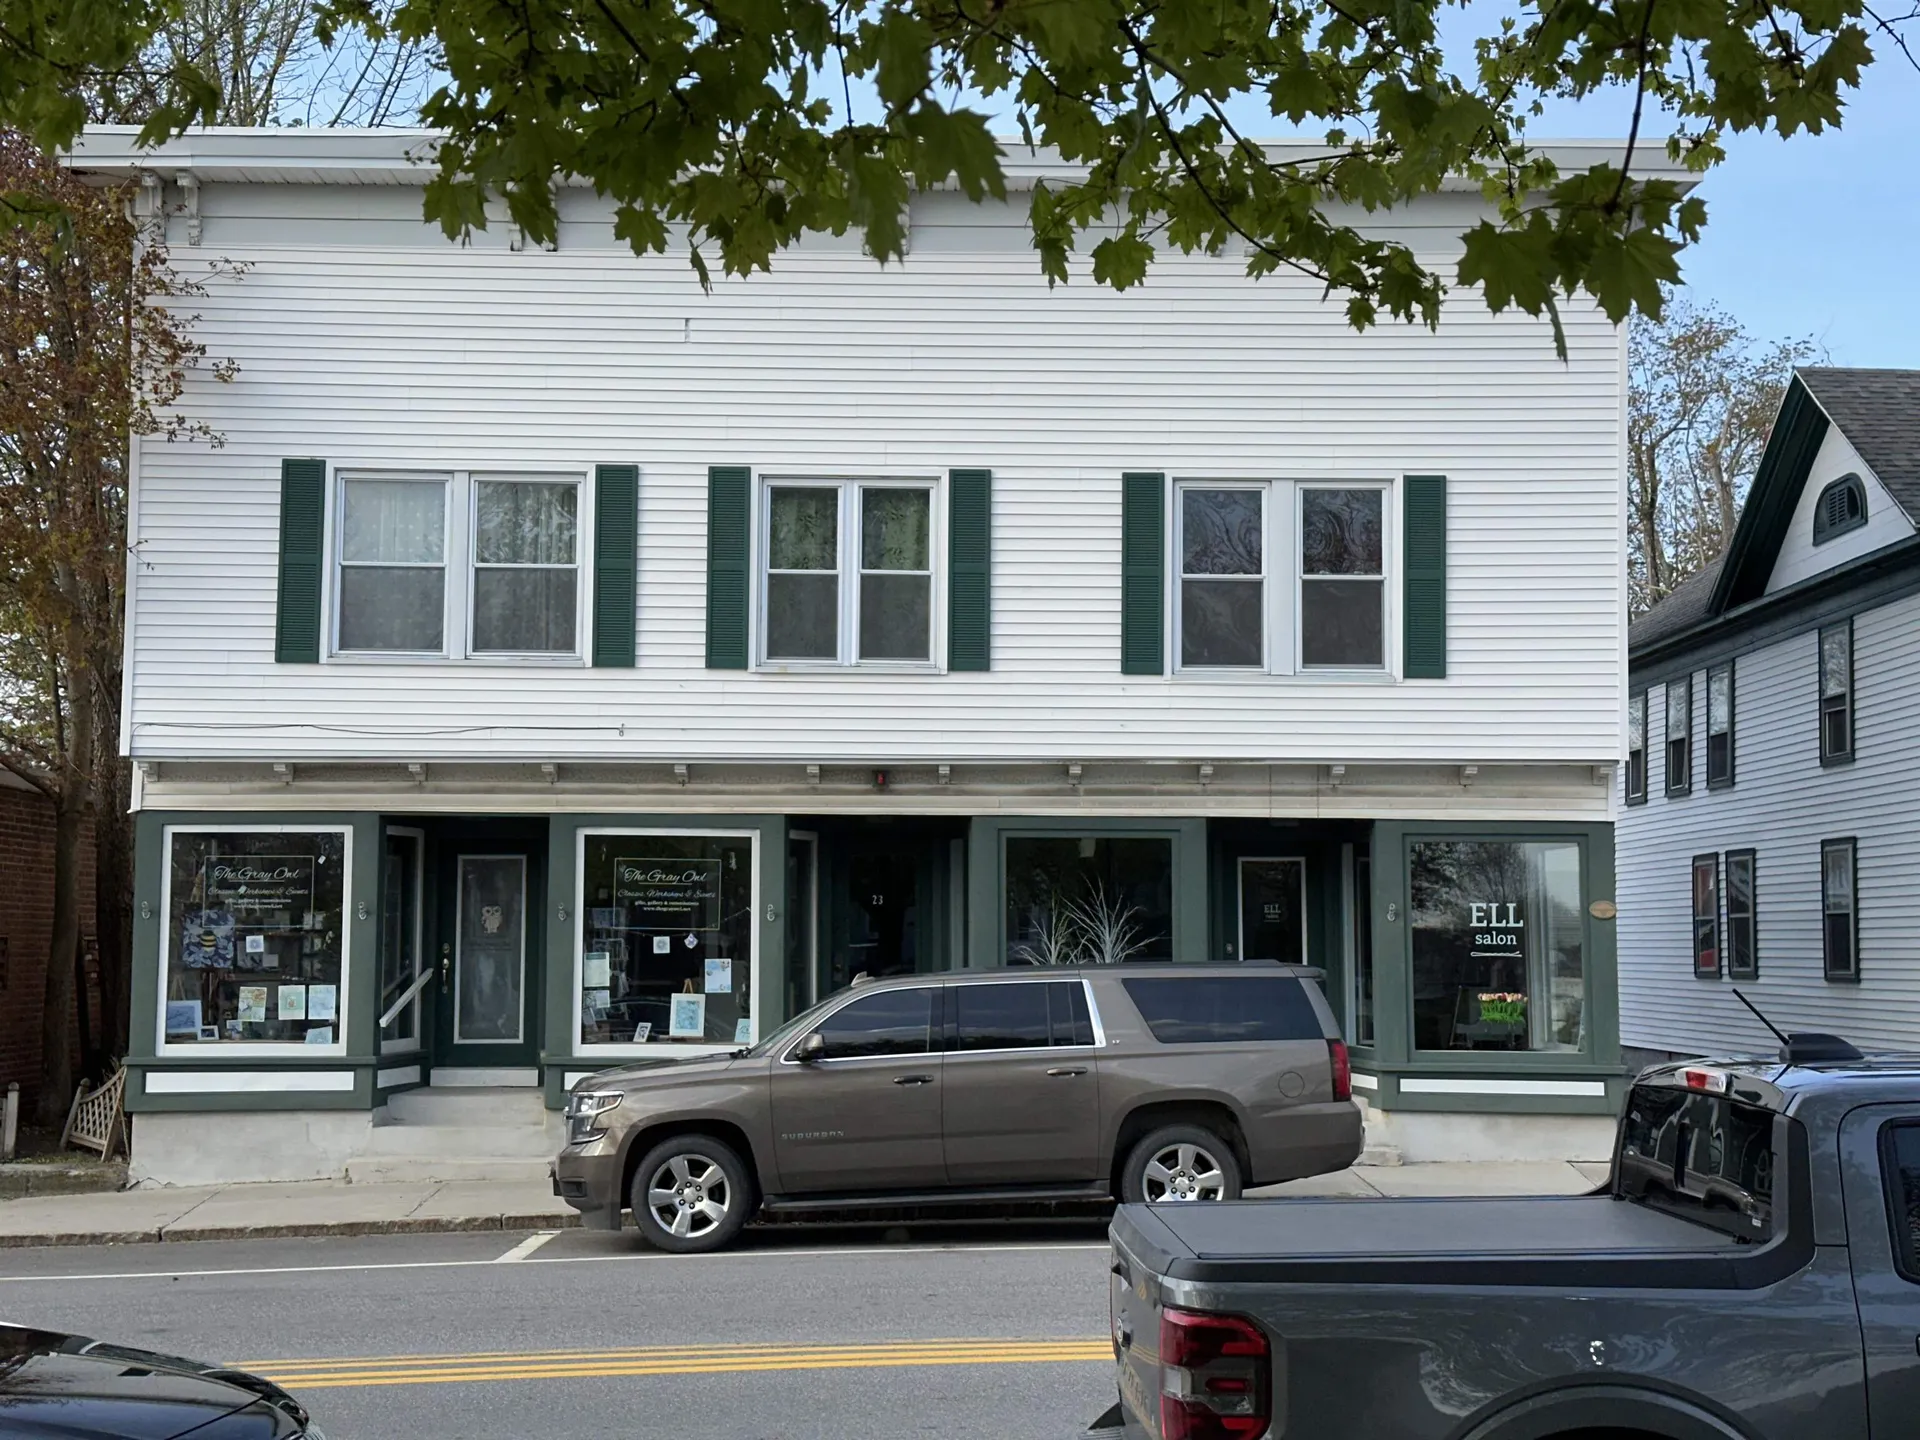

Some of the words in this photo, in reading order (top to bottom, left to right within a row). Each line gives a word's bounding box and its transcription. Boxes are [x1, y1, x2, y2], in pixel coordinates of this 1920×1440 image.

[214, 866, 237, 879] The
[238, 867, 272, 882] Gray
[273, 867, 300, 880] Owl
[624, 867, 646, 882] The
[647, 869, 681, 884] Gray
[682, 870, 707, 882] Owl
[646, 888, 684, 898] Workshops
[872, 895, 883, 905] 23
[1469, 903, 1524, 927] ELL
[1475, 931, 1517, 945] salon
